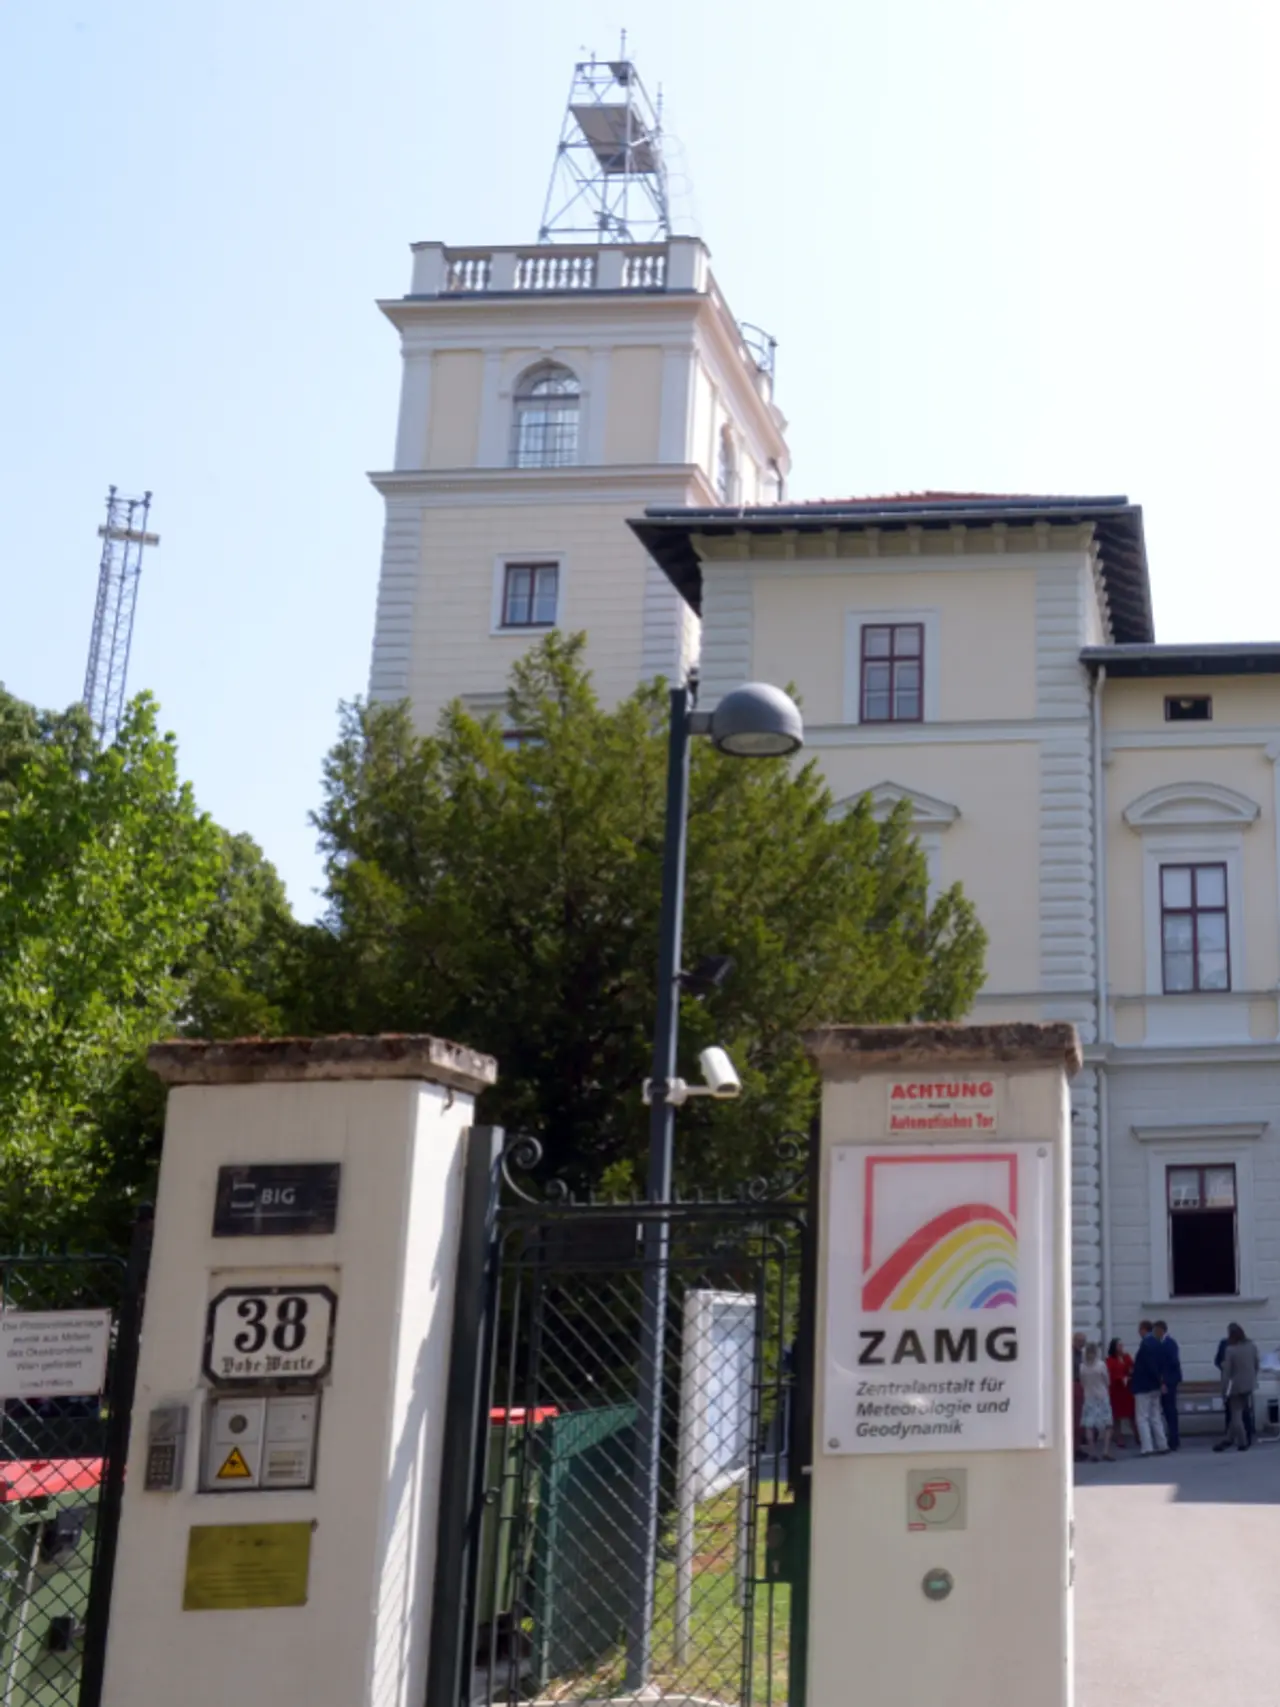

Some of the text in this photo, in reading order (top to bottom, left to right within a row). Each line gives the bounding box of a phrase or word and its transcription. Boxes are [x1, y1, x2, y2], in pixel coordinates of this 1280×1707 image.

[890, 1081, 994, 1100] ACHTUNG
[976, 1112, 994, 1129] Tor
[261, 1187, 297, 1205] BIG
[234, 1296, 308, 1354] 38
[858, 1326, 1019, 1366] ZAMG
[856, 1376, 1006, 1396] Zentralanstalt für
[856, 1398, 1011, 1418] Meteorologie und
[856, 1419, 963, 1440] Geodynamik
